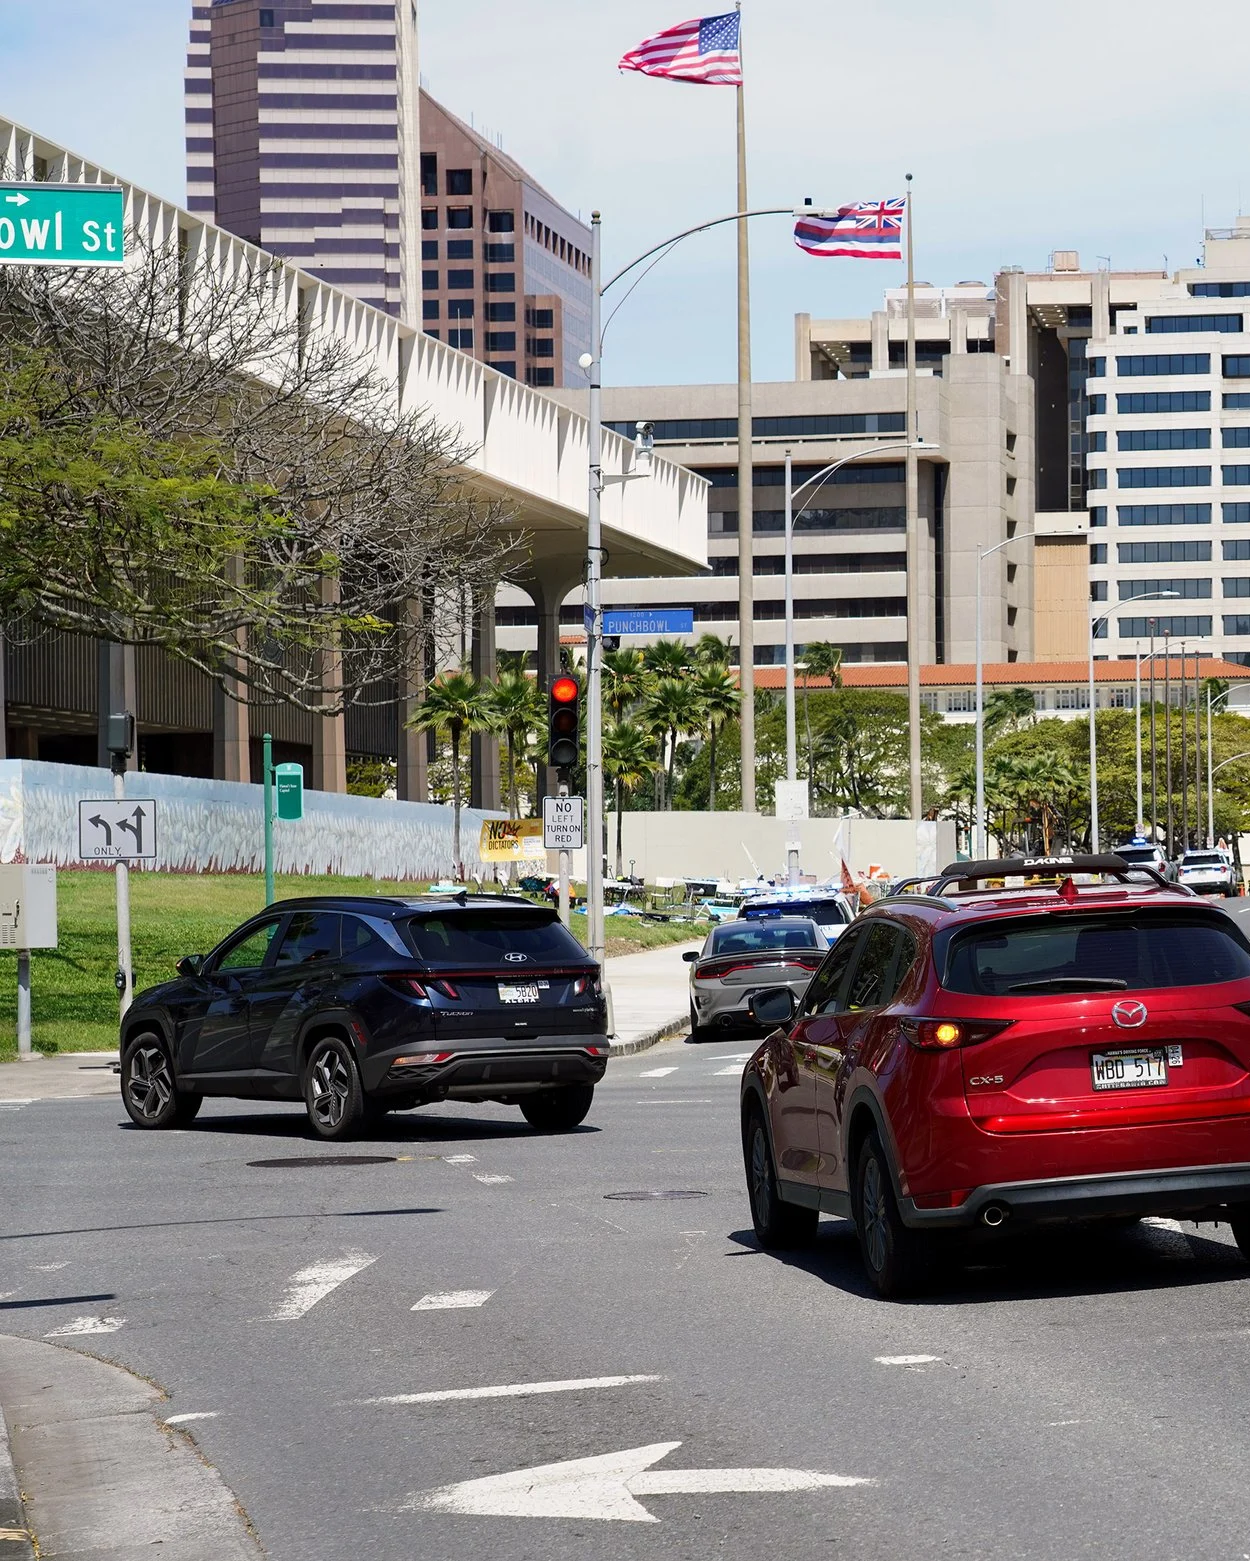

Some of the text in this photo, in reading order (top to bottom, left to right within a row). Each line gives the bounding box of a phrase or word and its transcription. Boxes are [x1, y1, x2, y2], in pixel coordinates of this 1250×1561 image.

[82, 220, 116, 252] St
[608, 620, 670, 633] PUNCHBOWL
[555, 802, 572, 813] NO
[551, 814, 574, 823] LEFT
[547, 824, 568, 833] TURN
[569, 824, 581, 833] ON
[555, 834, 572, 843] RED
[488, 840, 519, 850] DICTATORS
[93, 846, 121, 856] ONLY
[1023, 857, 1074, 866] DAKINE
[515, 985, 538, 998] 5820
[1095, 1057, 1162, 1080] WBD 517
[969, 1075, 1004, 1086] CX-5
